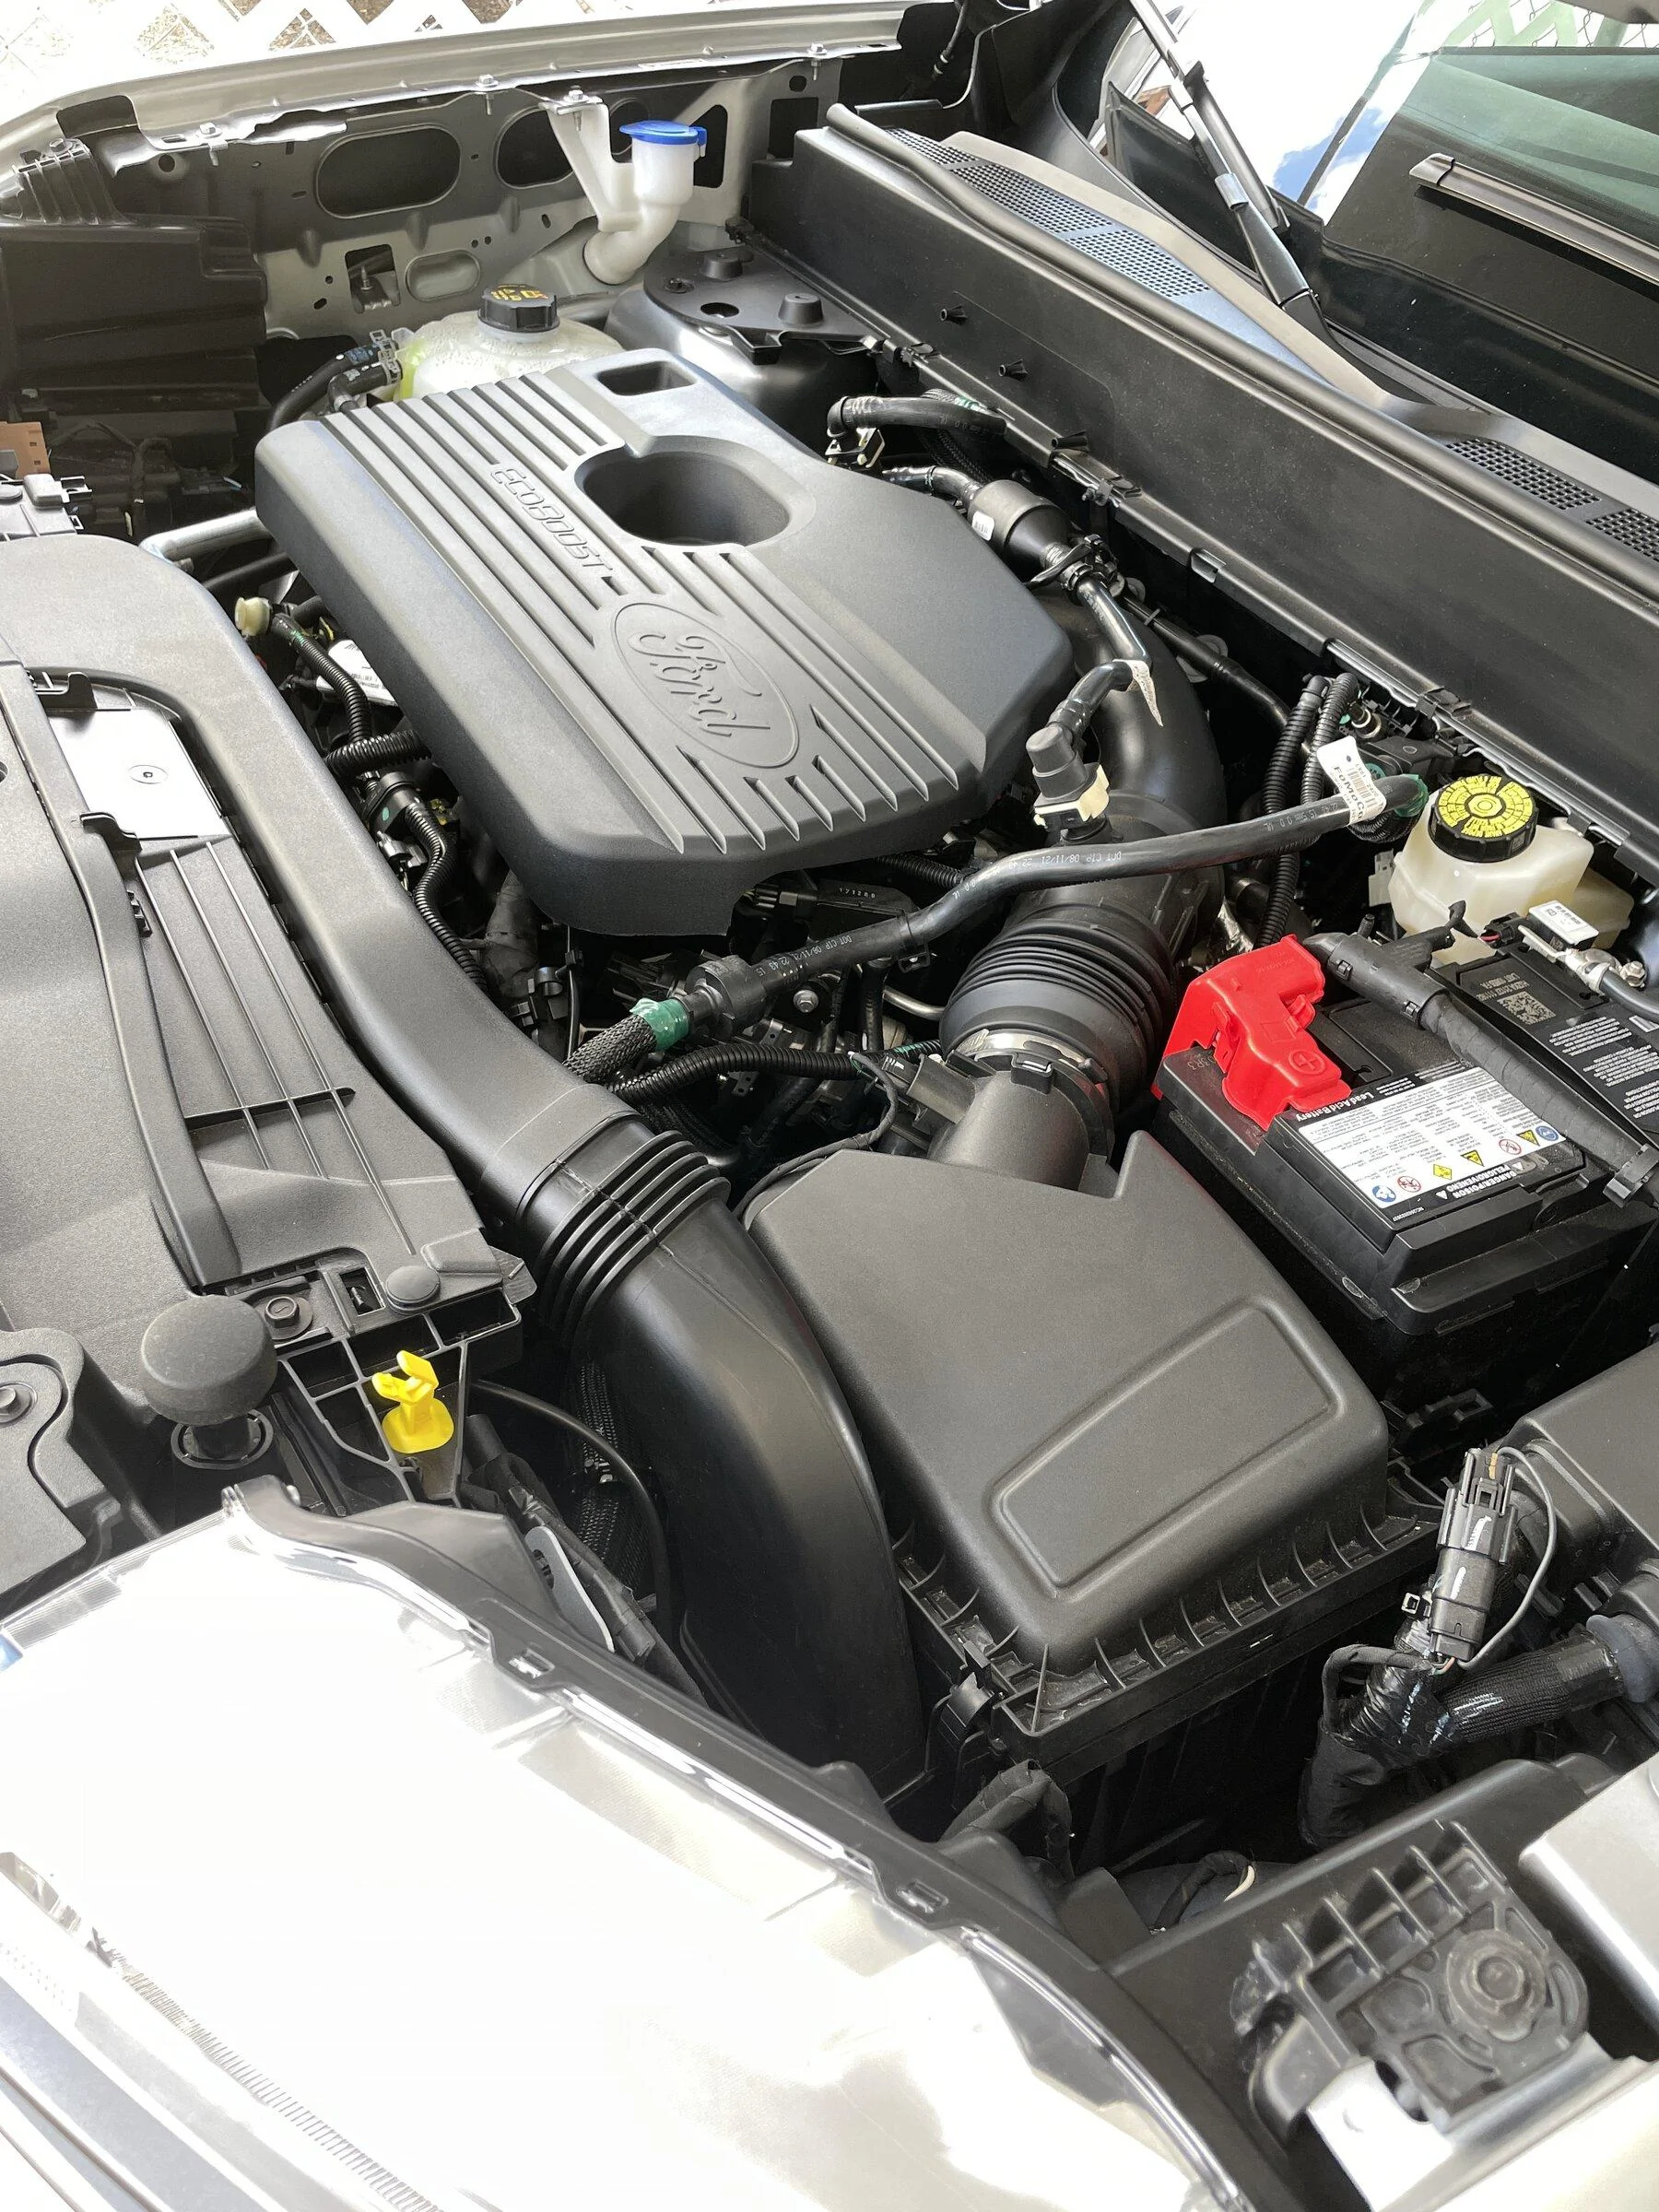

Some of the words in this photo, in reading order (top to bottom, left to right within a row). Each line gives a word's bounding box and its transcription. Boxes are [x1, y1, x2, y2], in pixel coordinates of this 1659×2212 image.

[489, 468, 614, 572] ECOBOOST
[627, 631, 772, 738] Ford
[1333, 765, 1365, 820] FoMoCo
[1041, 853, 1080, 865] 08/11/21
[1328, 1098, 1351, 1110] Acid
[1349, 1091, 1374, 1105] Lead
[1295, 1107, 1332, 1122] Battery
[1446, 1163, 1512, 1194] PELIGRO/VENENO
[1452, 1170, 1518, 1199] DANGER/POISON
